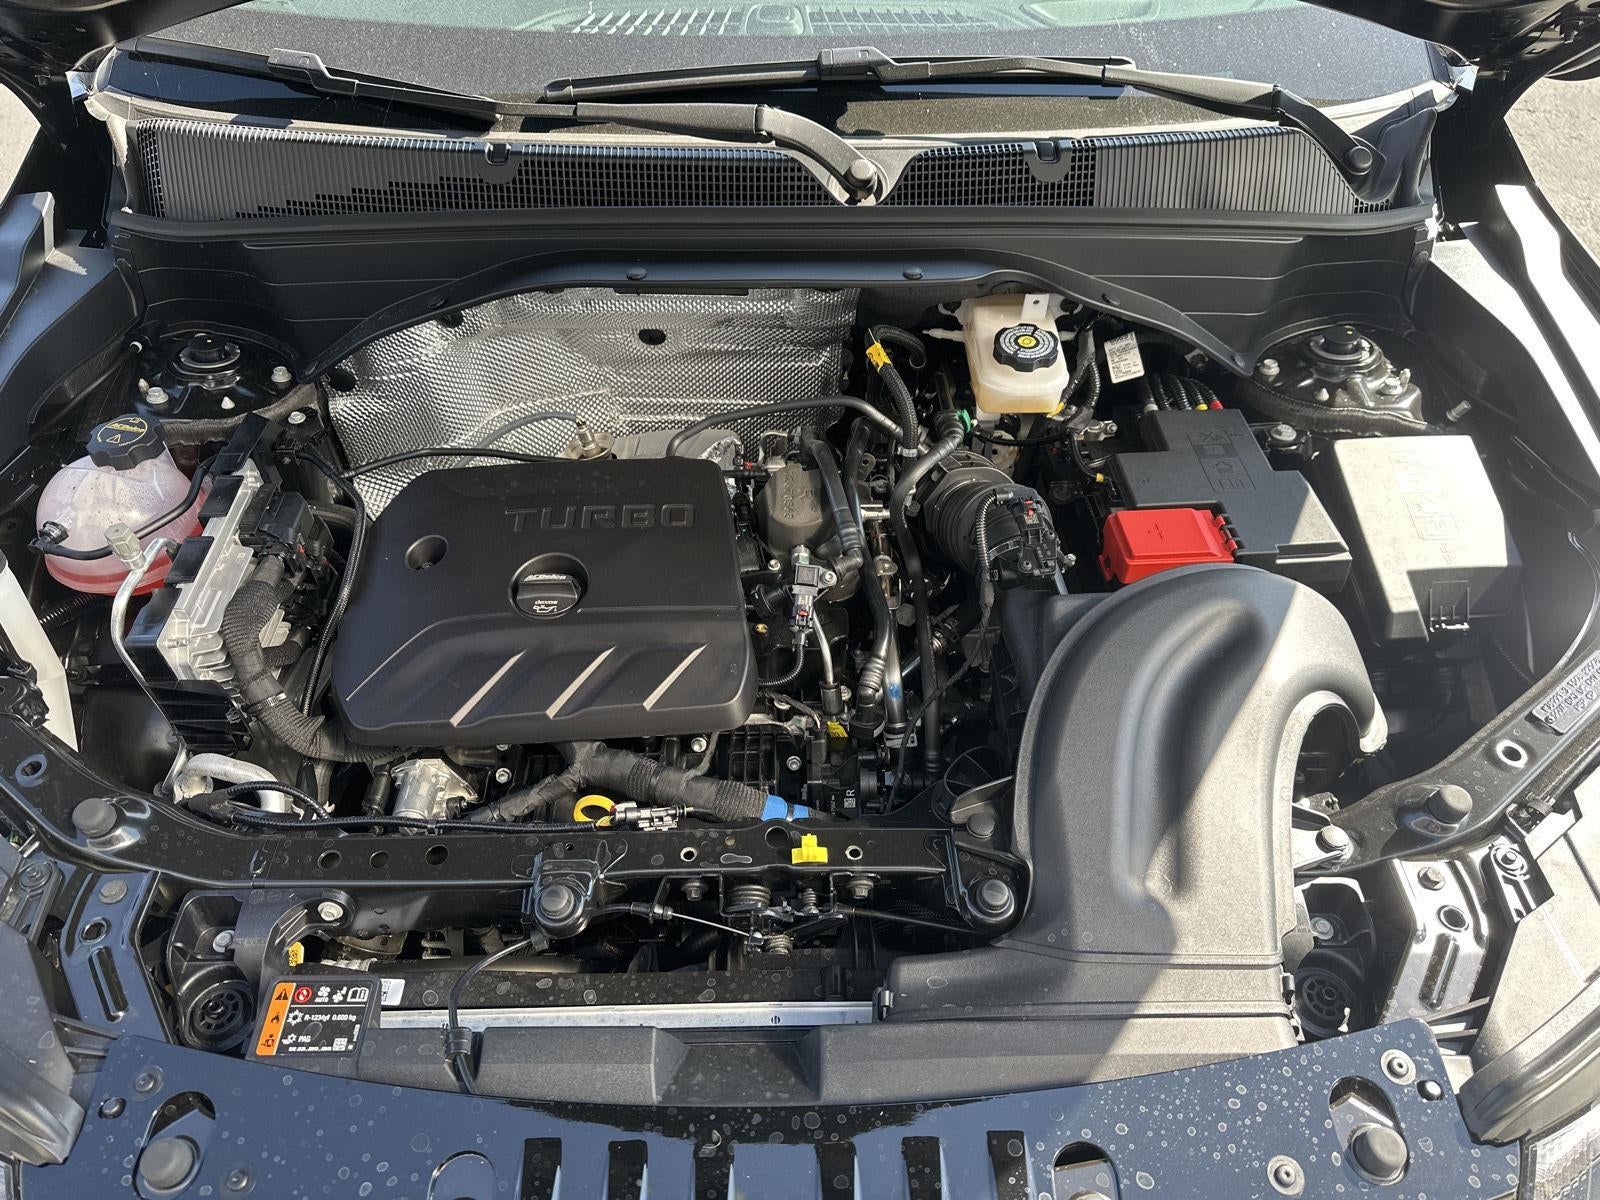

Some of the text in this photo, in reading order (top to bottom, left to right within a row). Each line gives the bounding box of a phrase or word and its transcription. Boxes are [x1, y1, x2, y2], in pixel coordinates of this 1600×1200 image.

[505, 504, 694, 532] TURBO
[349, 1014, 357, 1022] kg
[298, 1035, 312, 1043] PAG
